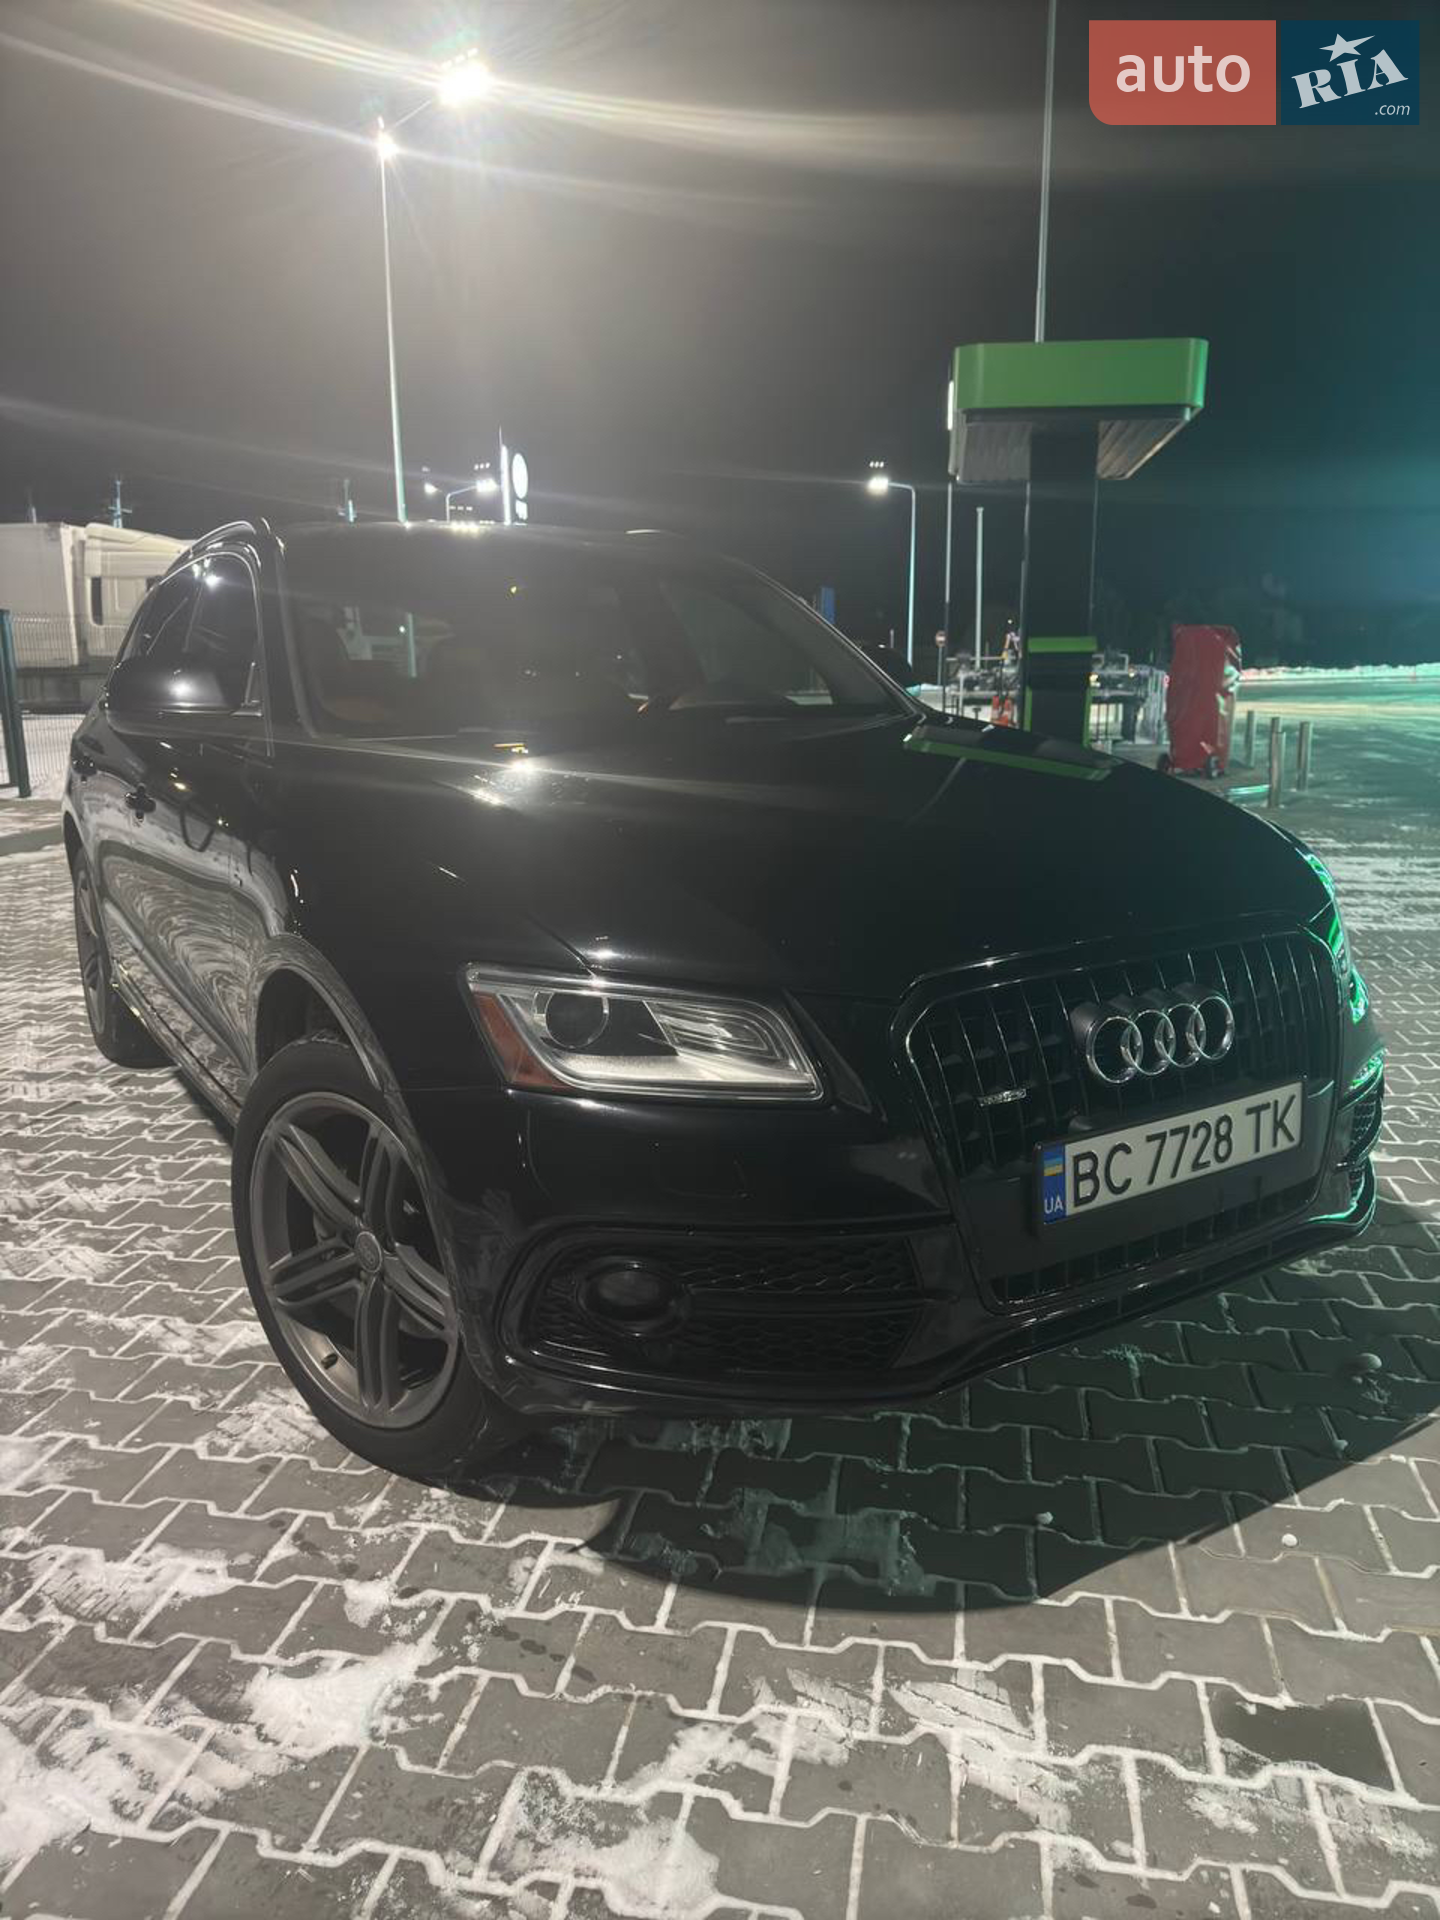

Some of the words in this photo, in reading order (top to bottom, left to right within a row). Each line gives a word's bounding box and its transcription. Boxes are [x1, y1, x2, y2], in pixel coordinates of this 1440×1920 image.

[1072, 1142, 1132, 1208] BC
[1145, 1114, 1234, 1186] 7728
[1245, 1094, 1296, 1153] TK
[1043, 1194, 1064, 1214] UA
